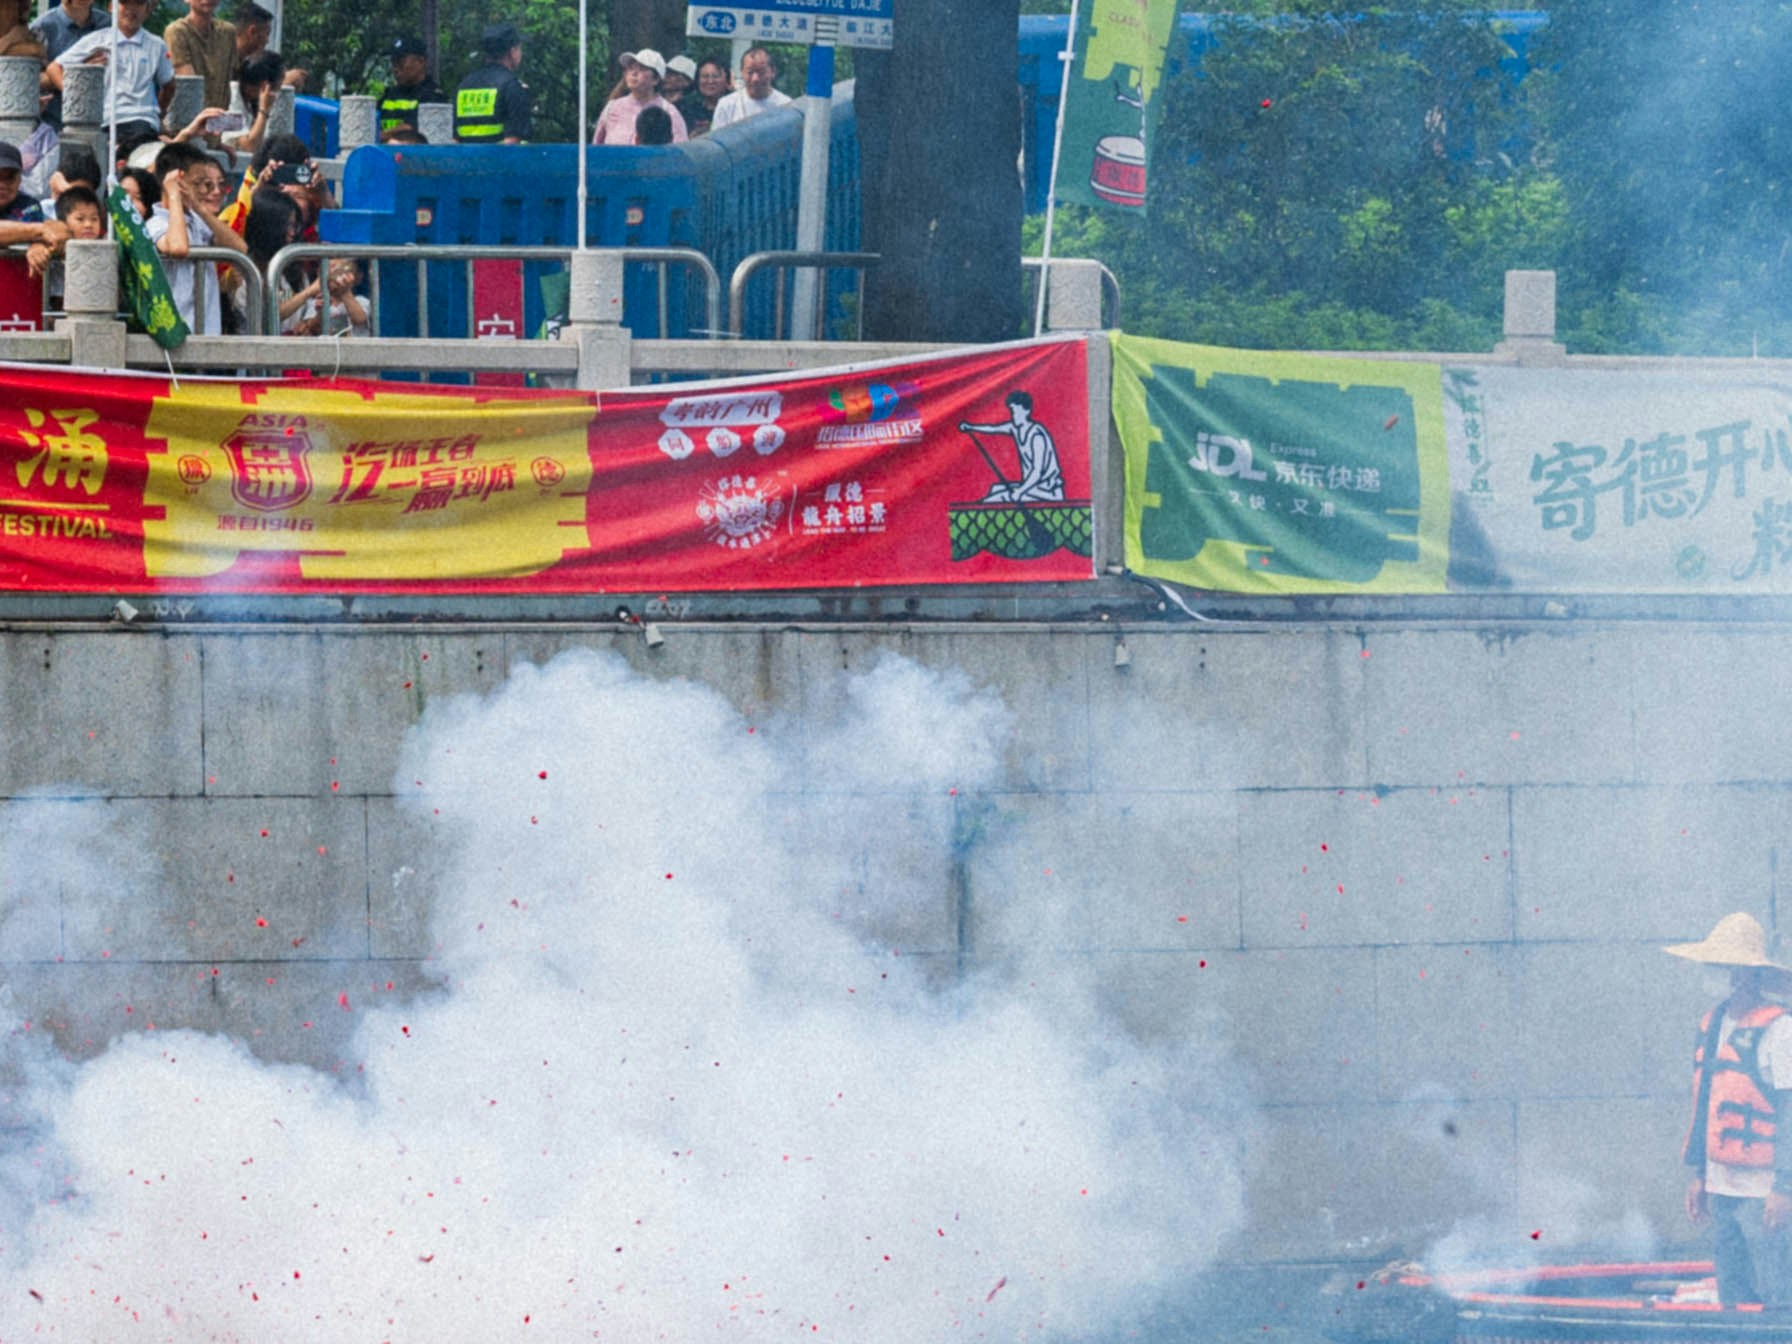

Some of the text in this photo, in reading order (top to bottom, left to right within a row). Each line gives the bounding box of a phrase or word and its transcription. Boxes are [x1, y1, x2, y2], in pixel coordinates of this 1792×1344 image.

[239, 413, 309, 428] ASIA
[1269, 441, 1317, 457] Express
[1272, 459, 1382, 493] 京东快递
